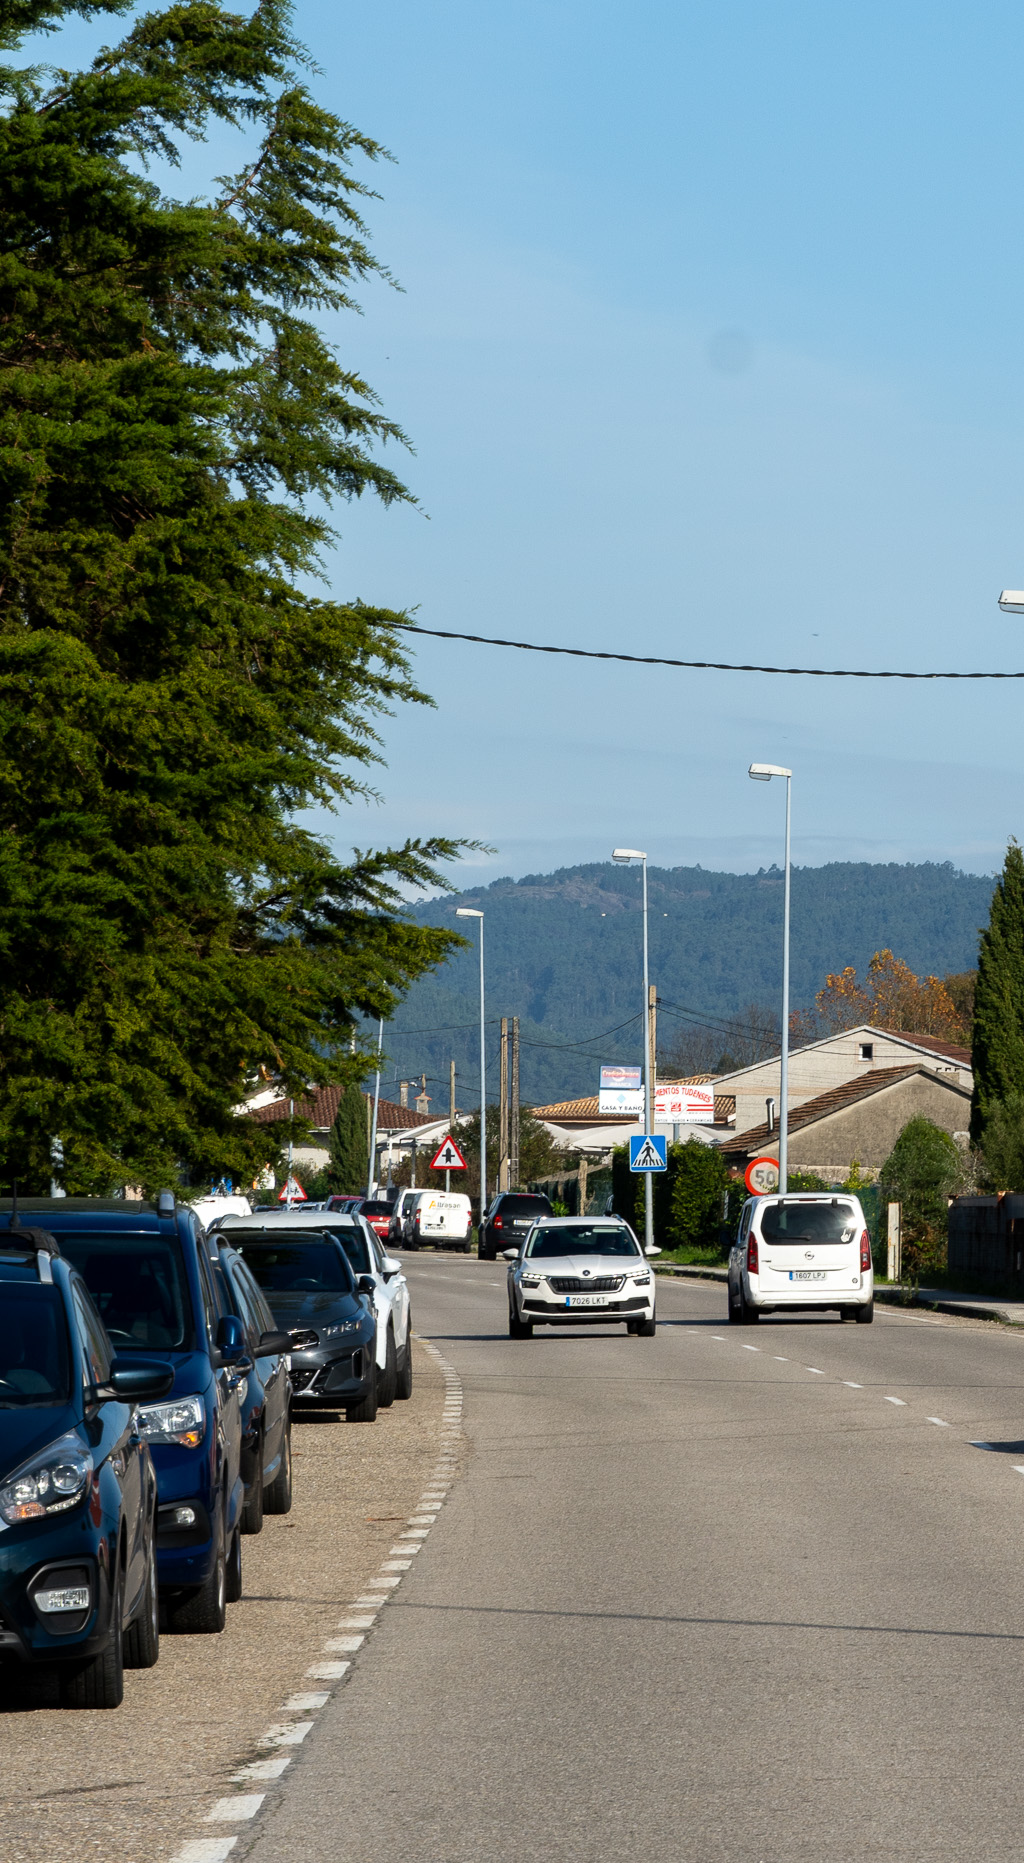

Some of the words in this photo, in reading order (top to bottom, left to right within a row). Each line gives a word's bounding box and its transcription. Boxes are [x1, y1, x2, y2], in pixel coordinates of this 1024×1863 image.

[681, 1087, 712, 1103] TUDENSES
[755, 1169, 776, 1186] 50
[572, 1297, 591, 1305] 7026
[592, 1297, 606, 1305] LKT
